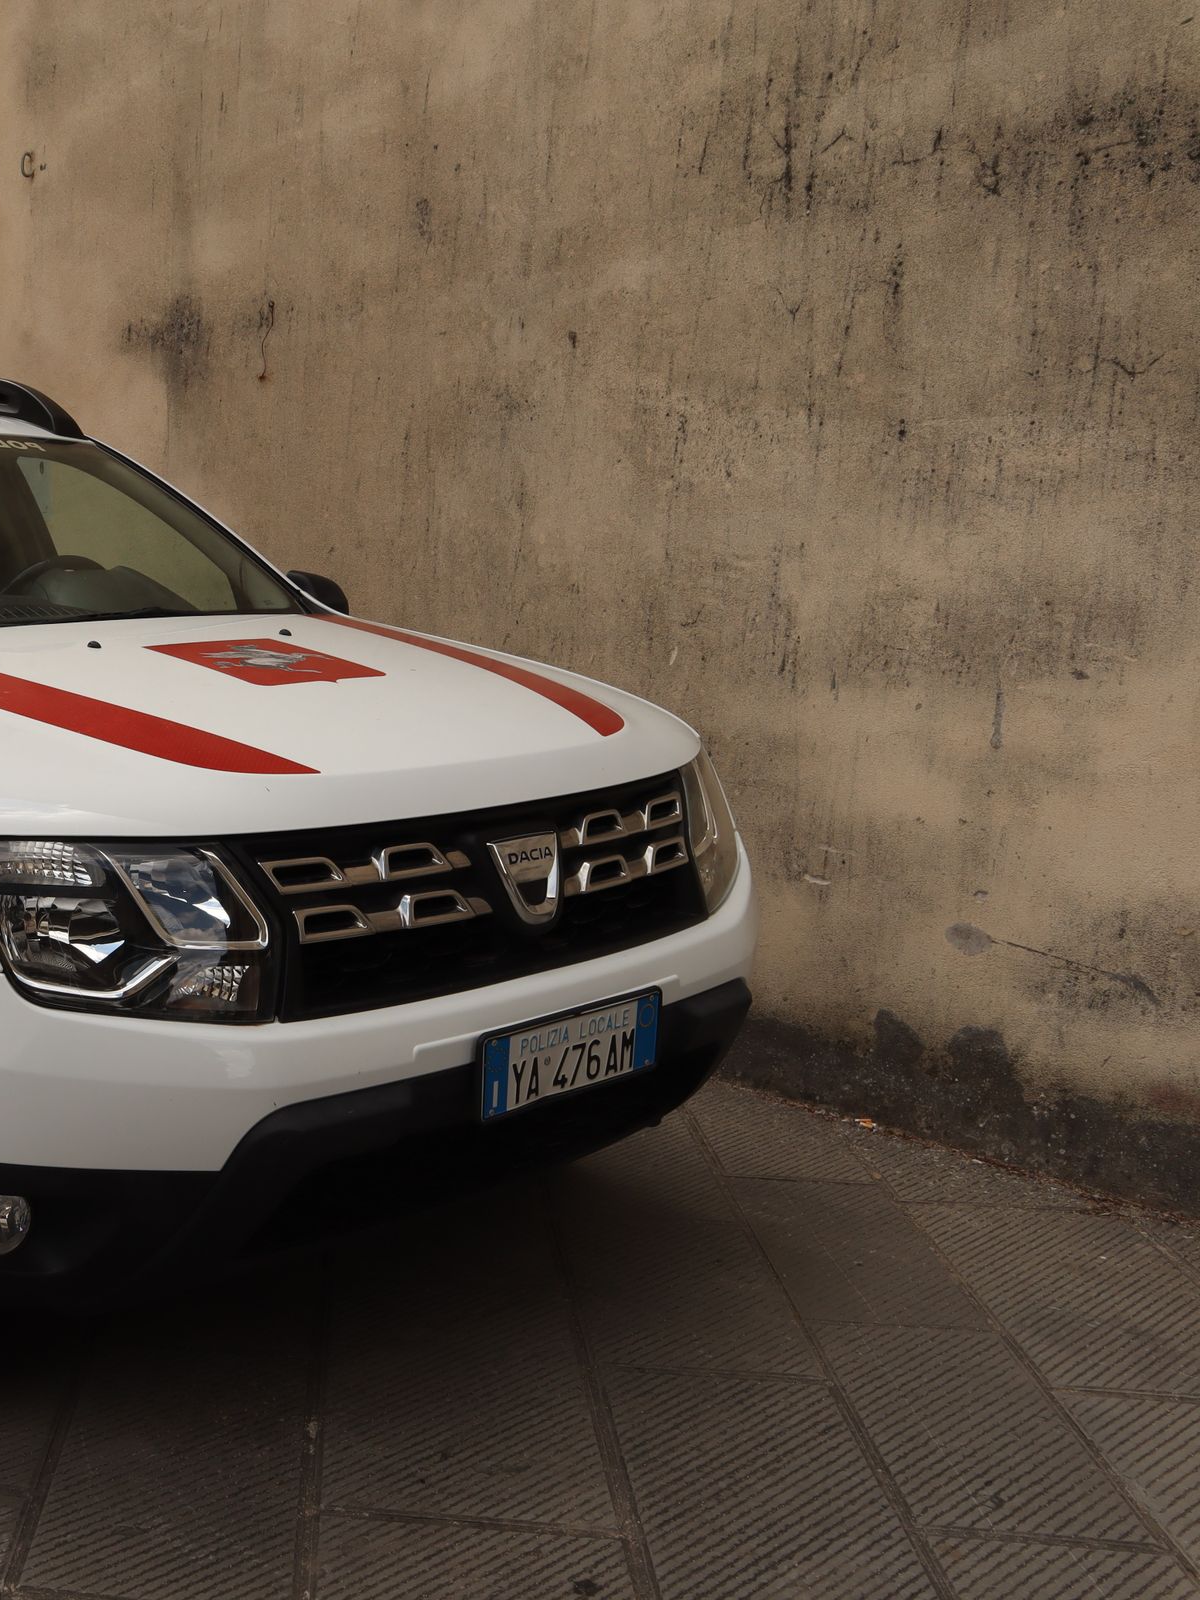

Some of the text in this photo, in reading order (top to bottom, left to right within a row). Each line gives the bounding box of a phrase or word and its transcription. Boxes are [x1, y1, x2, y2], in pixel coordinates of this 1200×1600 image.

[507, 846, 553, 865] DACIA
[521, 1008, 630, 1056] POLIZIA LOCALE
